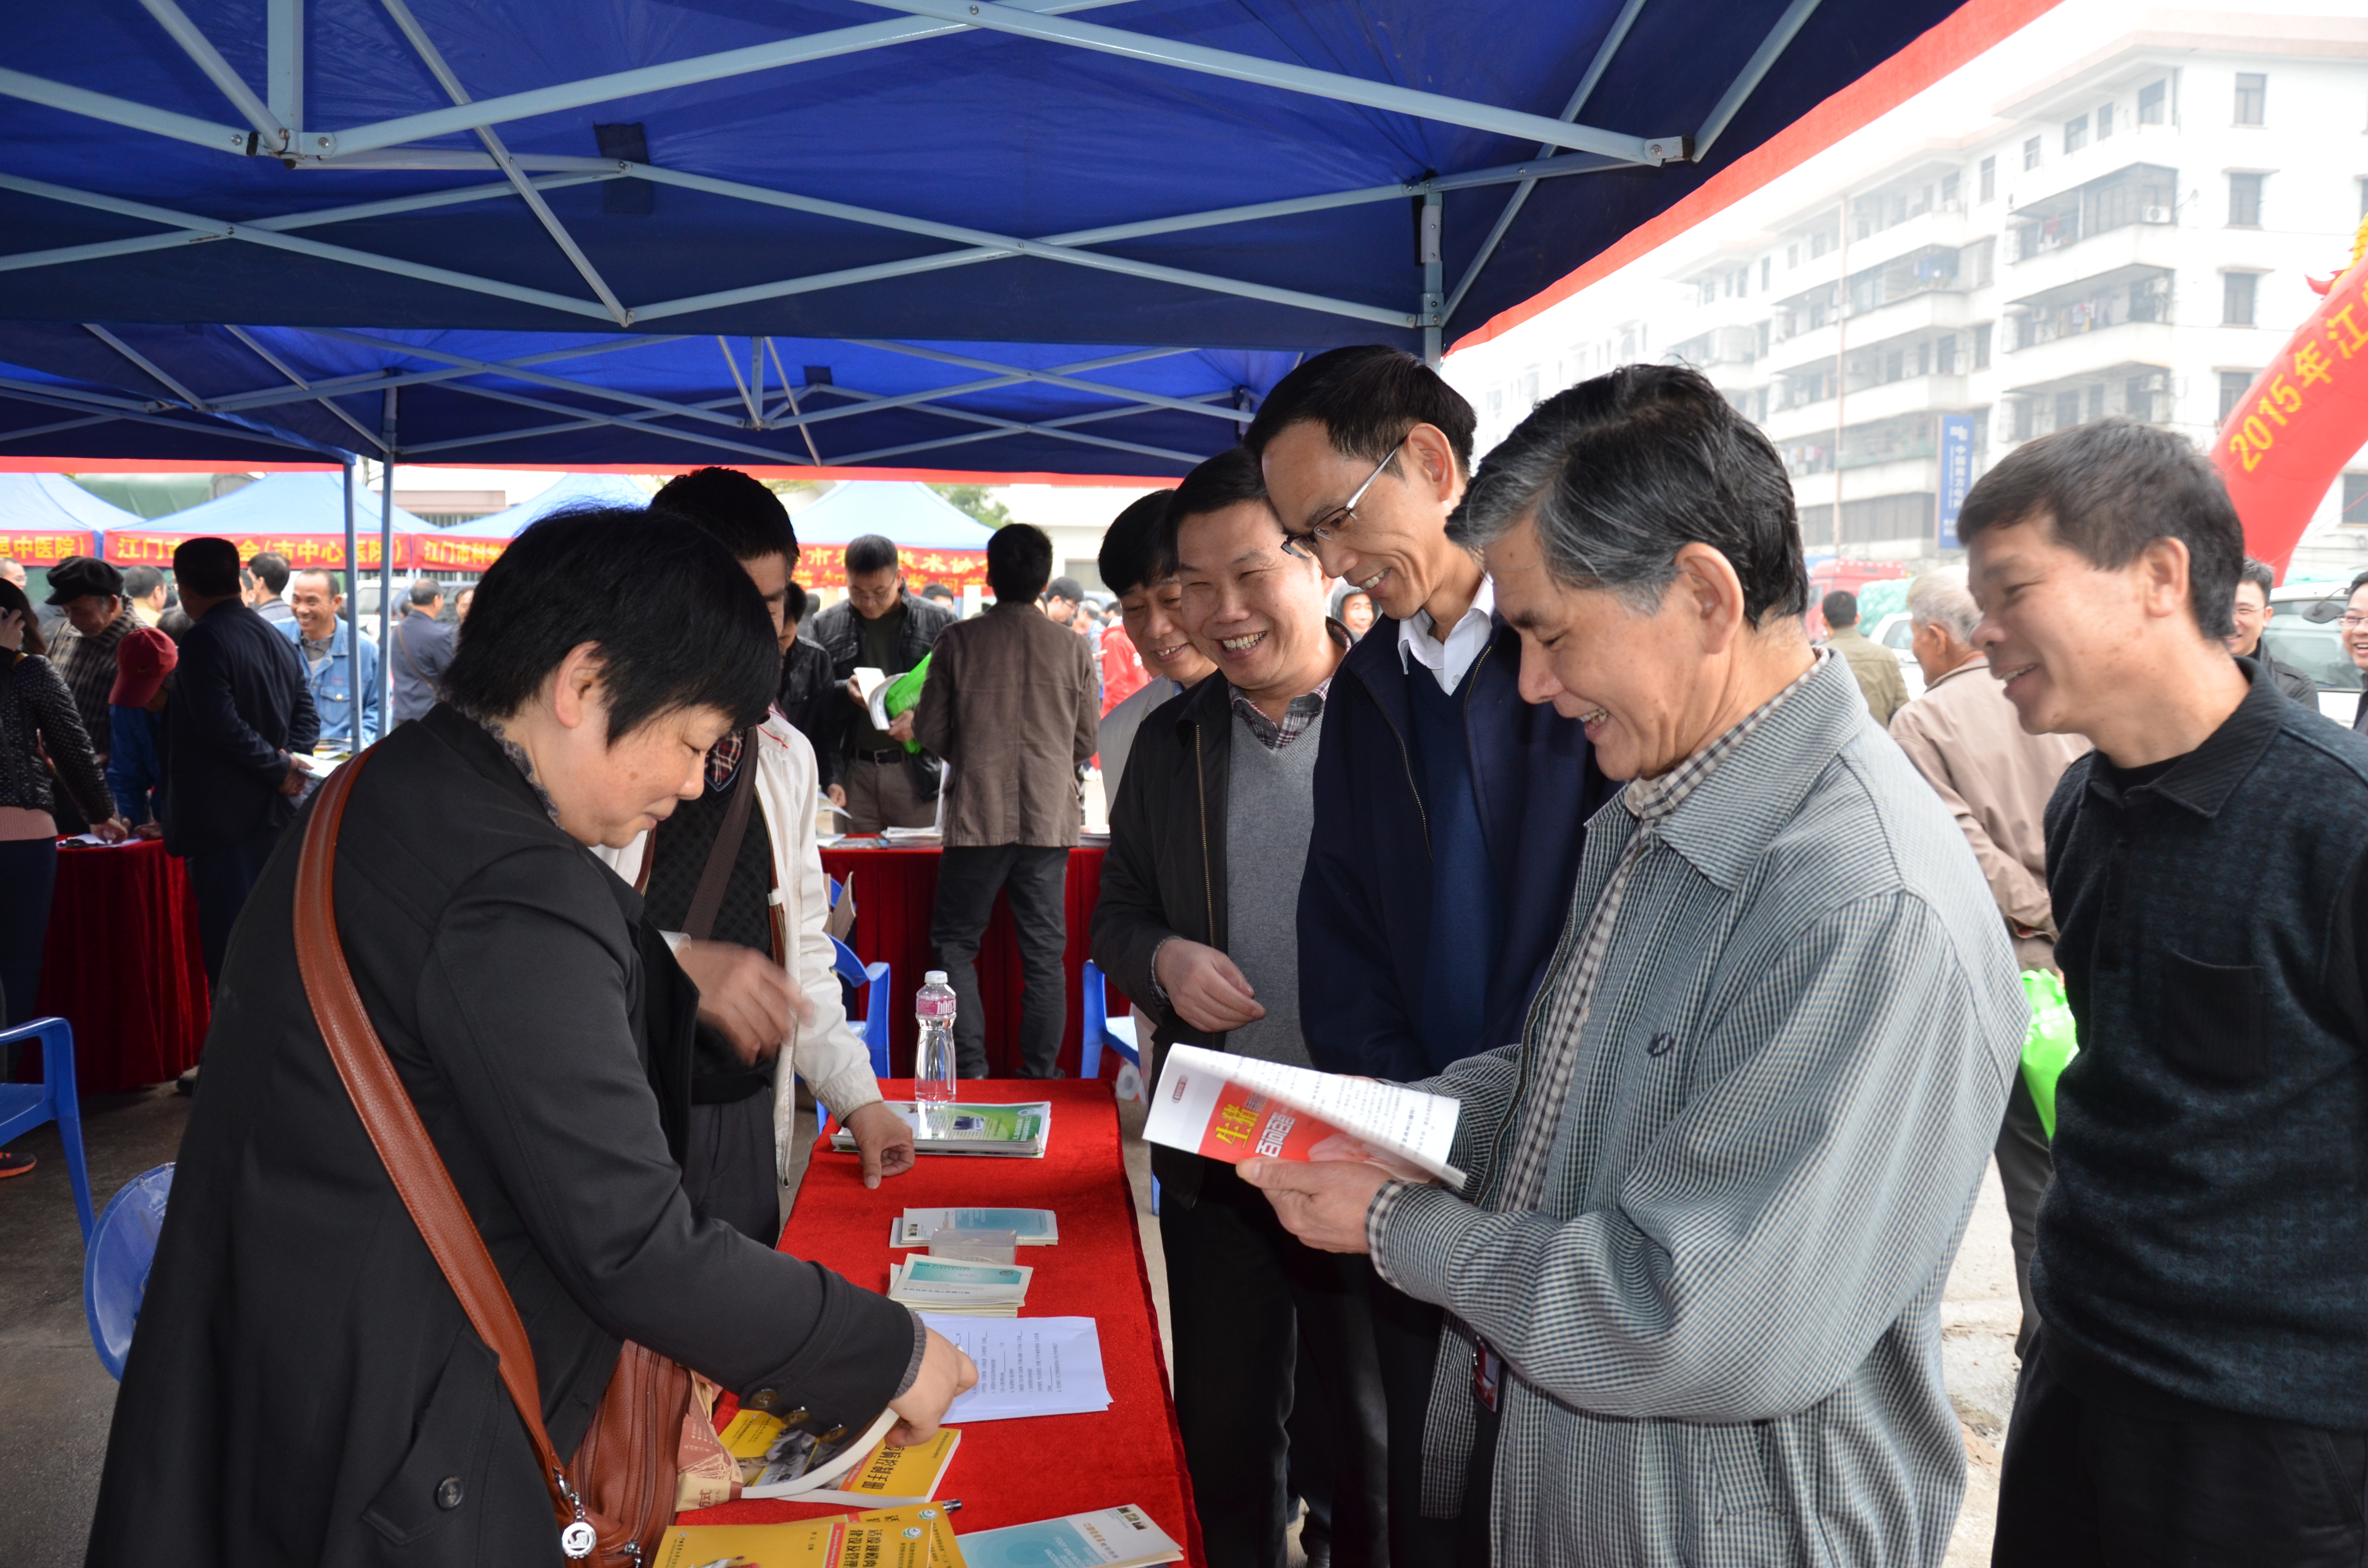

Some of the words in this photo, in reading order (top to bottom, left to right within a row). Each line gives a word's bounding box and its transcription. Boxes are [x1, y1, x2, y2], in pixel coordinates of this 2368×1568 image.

[424, 540, 506, 564] 江门市科学
[1215, 1103, 1260, 1150] 生猪
